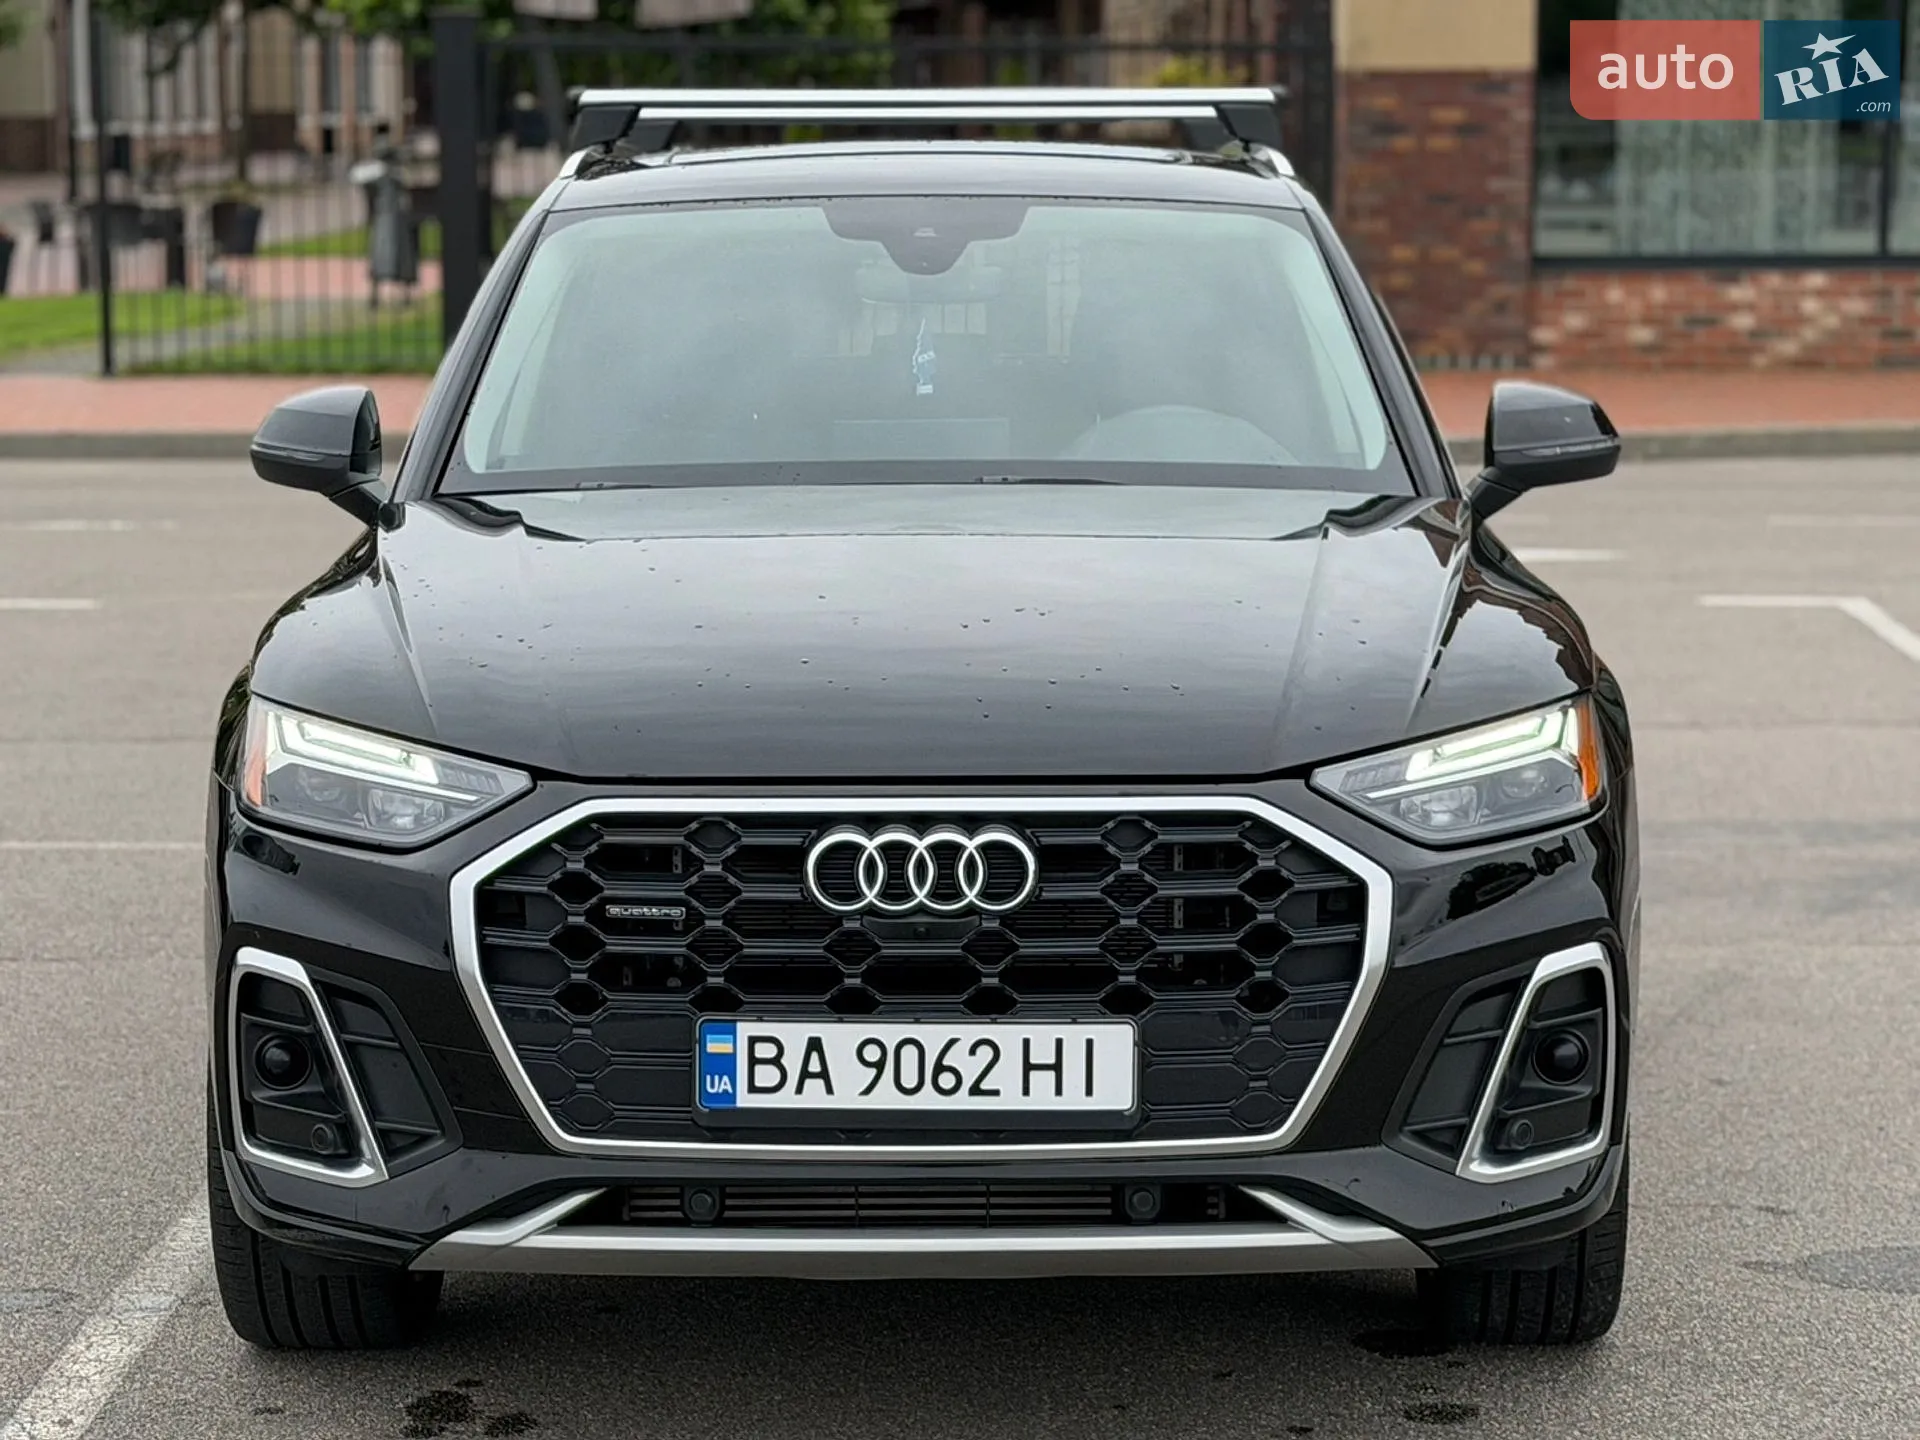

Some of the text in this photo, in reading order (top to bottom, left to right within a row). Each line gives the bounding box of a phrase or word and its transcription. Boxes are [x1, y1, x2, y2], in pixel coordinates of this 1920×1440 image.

[609, 907, 681, 916] quattro
[746, 1035, 1095, 1098] BA 9062 HI
[705, 1074, 733, 1094] UA
